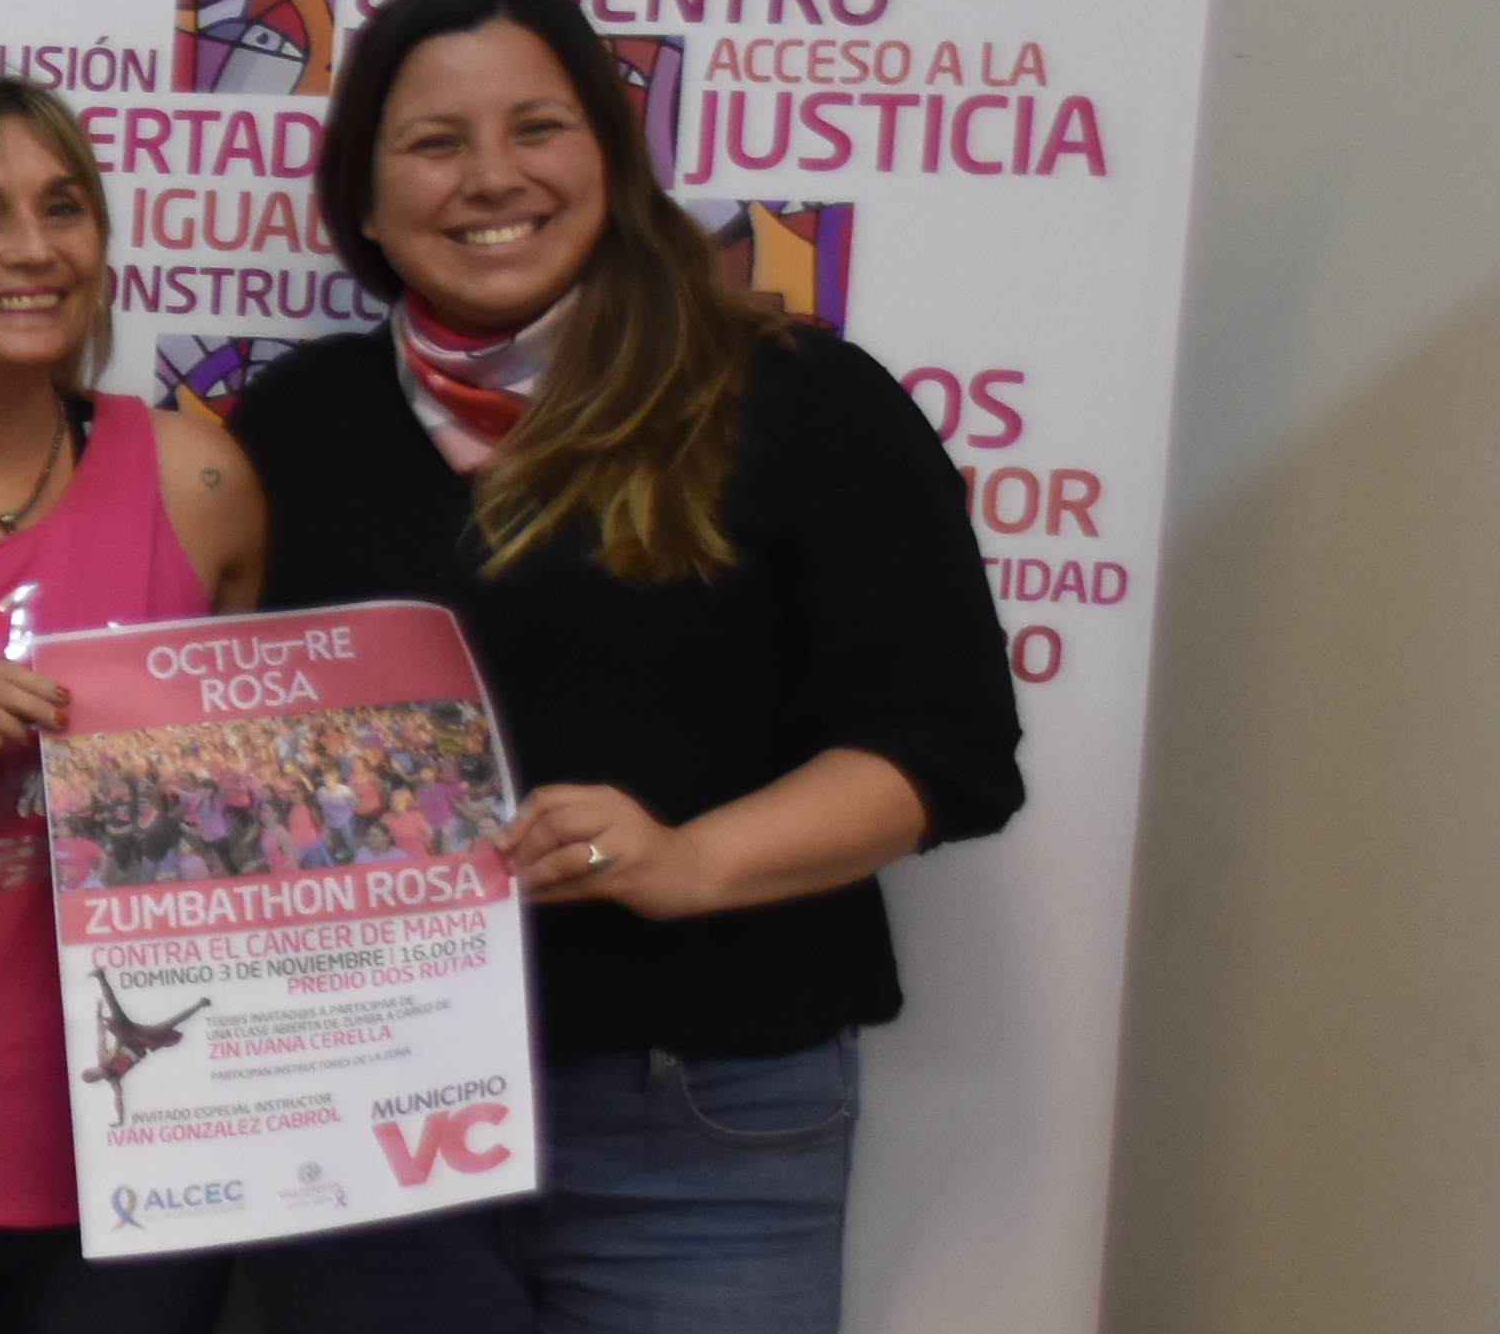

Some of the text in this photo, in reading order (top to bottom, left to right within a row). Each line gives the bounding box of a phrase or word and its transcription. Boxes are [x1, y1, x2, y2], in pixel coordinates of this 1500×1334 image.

[704, 38, 1047, 87] ACCESO A LA
[683, 90, 1107, 185] JUSTICIA
[201, 669, 319, 713] ROSA
[84, 862, 485, 936] ZUMBATHON ROSA
[91, 938, 201, 969] CONTRA
[210, 936, 239, 961] EL
[360, 920, 396, 946] DE
[403, 909, 488, 942] MAMA
[120, 933, 487, 989] DOMINGO 3 DE NOVIEMBRE 16.00 HS
[287, 950, 487, 995] PREDIO DOS RUTAS
[209, 1025, 391, 1060] ZIN IVANA CERELLA
[371, 1075, 507, 1121] MUNICIPIO
[159, 1117, 261, 1143] GONZALEZ
[266, 1106, 342, 1132] CABROL
[371, 1101, 511, 1188] VC
[144, 1179, 243, 1211] ALCEC
